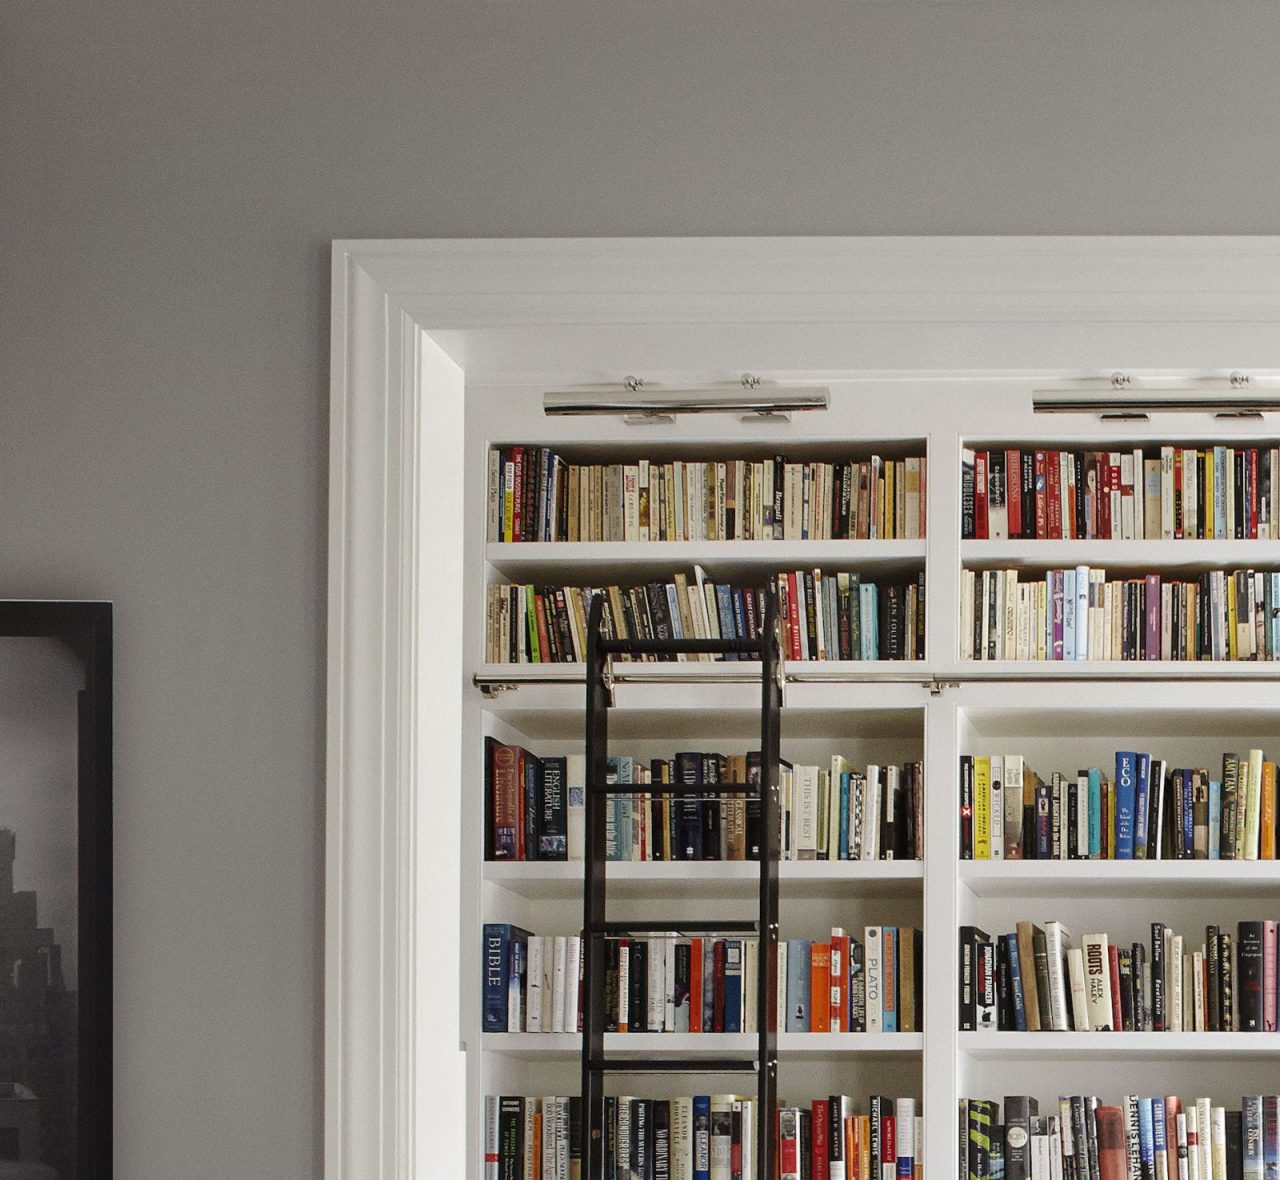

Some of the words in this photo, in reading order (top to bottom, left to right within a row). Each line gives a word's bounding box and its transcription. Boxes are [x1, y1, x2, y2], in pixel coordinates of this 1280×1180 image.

[1010, 453, 1019, 502] BIRDSONG
[1111, 467, 1119, 490] FORD
[963, 474, 973, 515] MIDDLESEX
[890, 598, 898, 616] KEN
[1121, 757, 1130, 787] ECO
[1224, 758, 1236, 775] AMY
[544, 770, 553, 822] LITERATURE
[552, 770, 561, 810] ENGLISH
[803, 777, 812, 799] THIS
[1224, 775, 1236, 792] TAN
[735, 800, 744, 835] CLASSICAL
[803, 800, 812, 810] IS
[727, 800, 736, 844] LITERATURE
[802, 817, 812, 840] BEST
[1153, 925, 1161, 939] Saul
[488, 937, 501, 987] BIBLE
[1086, 944, 1103, 975] ROOTS
[1154, 940, 1162, 962] Bellow
[868, 958, 878, 1000] PLATO
[984, 976, 993, 1004] FRANZEN
[1089, 978, 1098, 1004] HALEY
[546, 1103, 554, 1115] Bob
[619, 1101, 630, 1116] THE
[1129, 1095, 1140, 1140] DENNIS
[546, 1116, 554, 1150] Woodward
[619, 1115, 630, 1165] CONQUERORS
[655, 1128, 668, 1138] NO
[546, 1152, 554, 1164] The
[655, 1139, 668, 1172] ORDINARY
